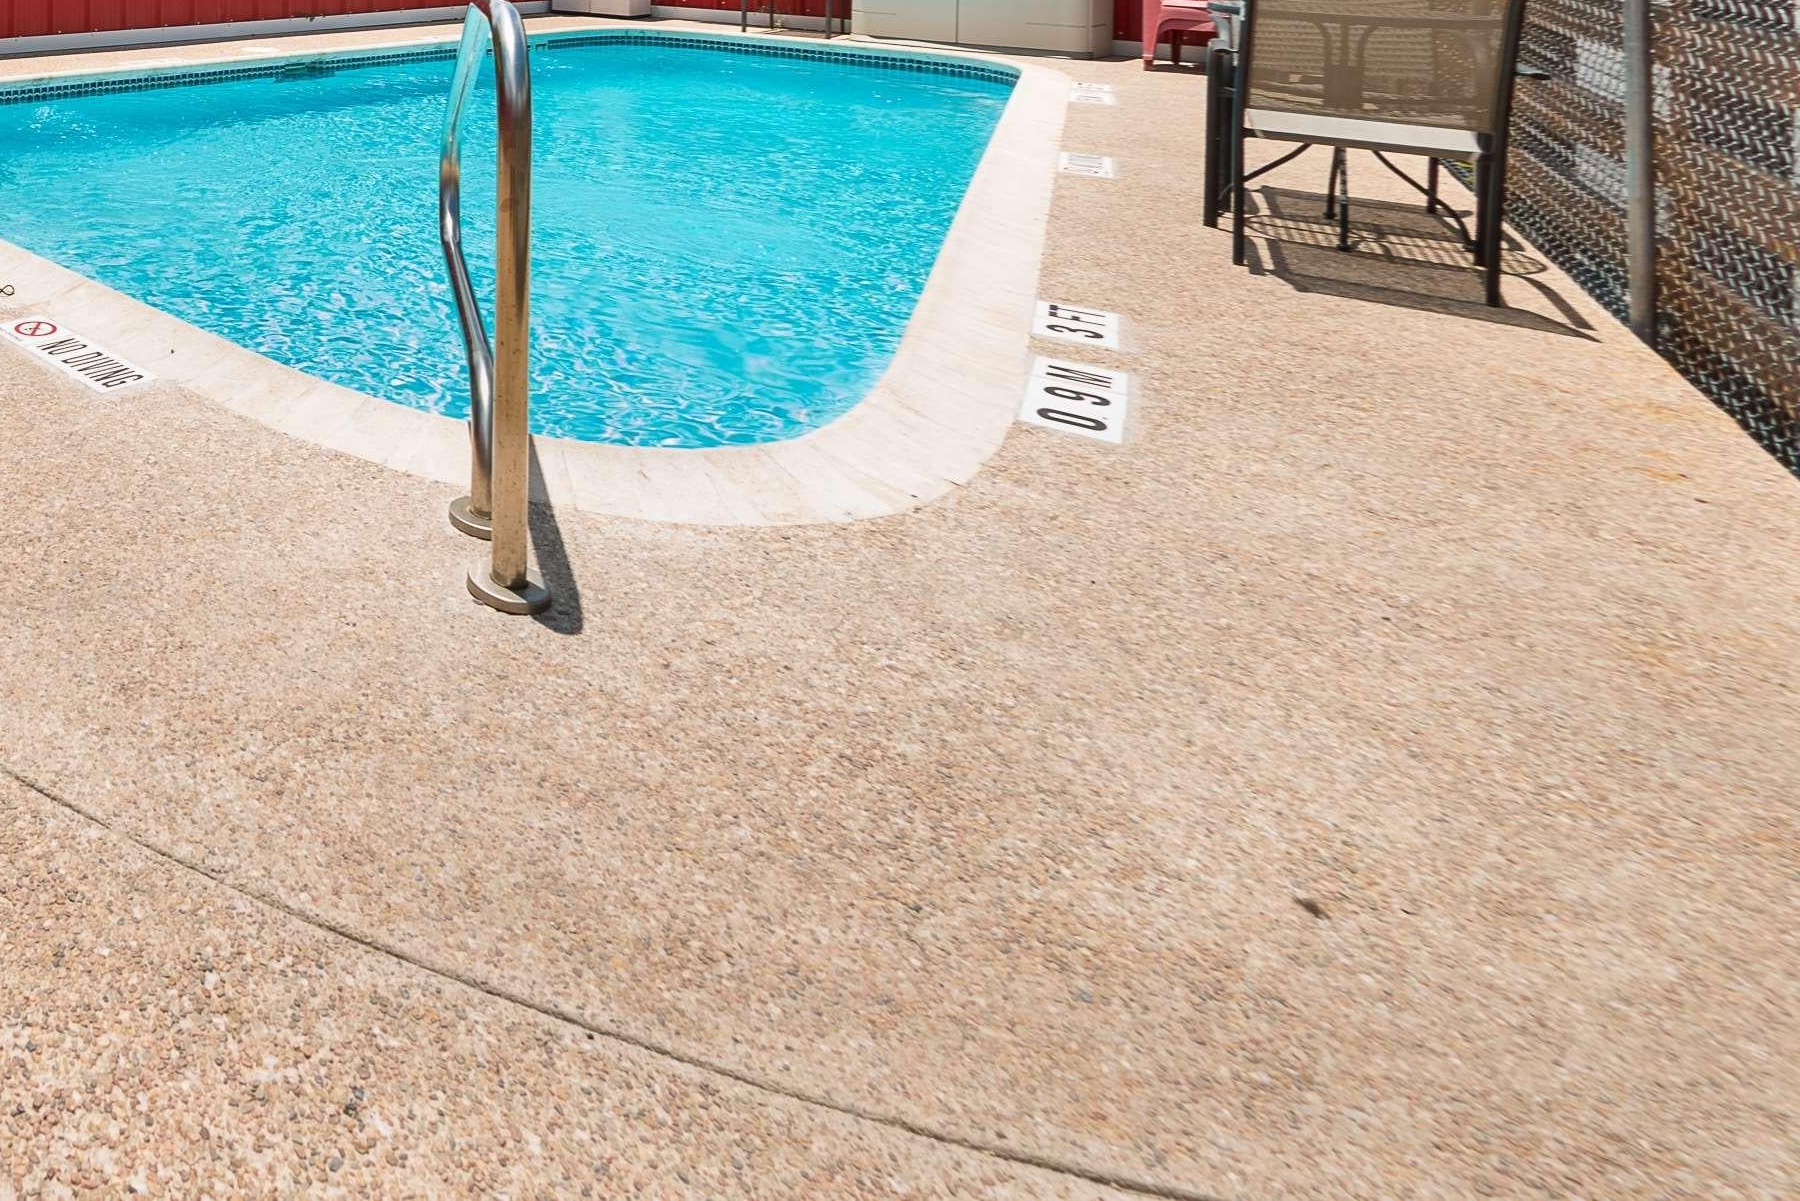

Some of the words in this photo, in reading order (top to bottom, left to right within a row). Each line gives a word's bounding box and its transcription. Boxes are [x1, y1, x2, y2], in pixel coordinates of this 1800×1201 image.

[1048, 304, 1106, 327] FT
[1046, 324, 1105, 339] 3
[36, 338, 88, 355] NO
[61, 352, 144, 388] DIVING
